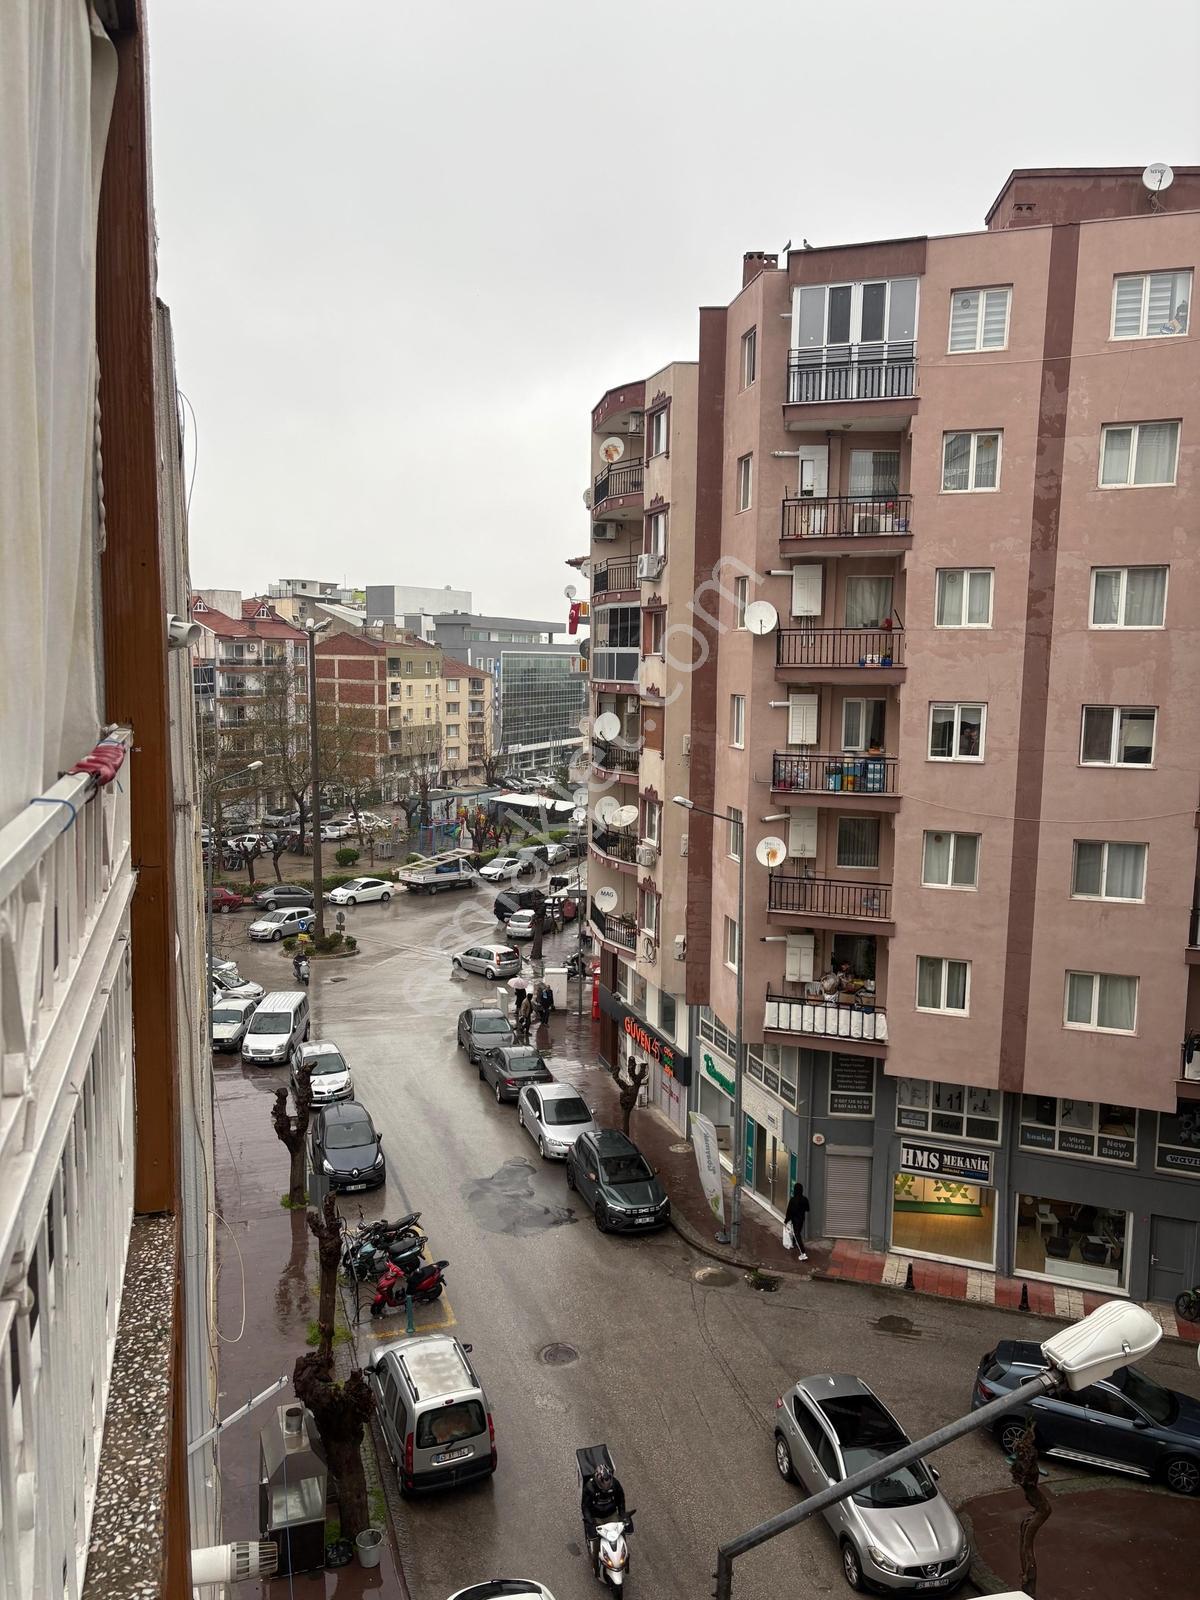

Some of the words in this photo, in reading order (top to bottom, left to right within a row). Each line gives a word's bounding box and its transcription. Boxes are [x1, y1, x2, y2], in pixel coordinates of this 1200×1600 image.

[624, 1016, 651, 1055] GÜVEN
[1102, 1147, 1130, 1158] Banyo
[1106, 1140, 1127, 1149] New
[901, 1148, 940, 1170] HMS
[942, 1153, 989, 1171] MEKANİK
